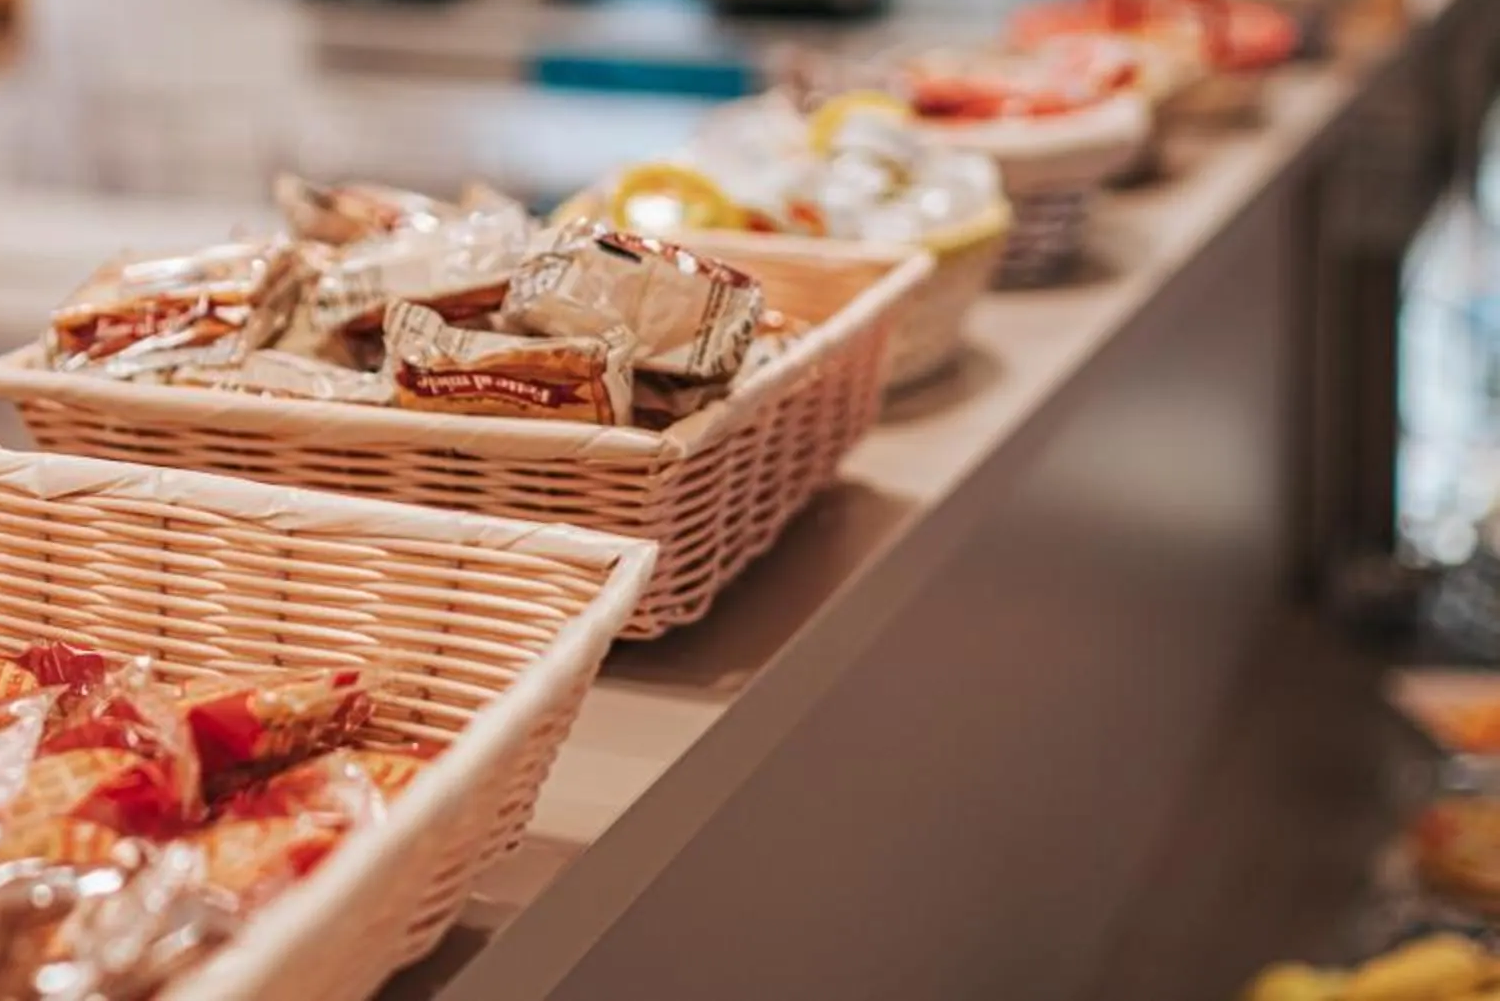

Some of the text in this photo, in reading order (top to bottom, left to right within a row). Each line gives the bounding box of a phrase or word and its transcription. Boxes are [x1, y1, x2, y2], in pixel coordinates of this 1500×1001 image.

[416, 374, 550, 403] Fette al miele
